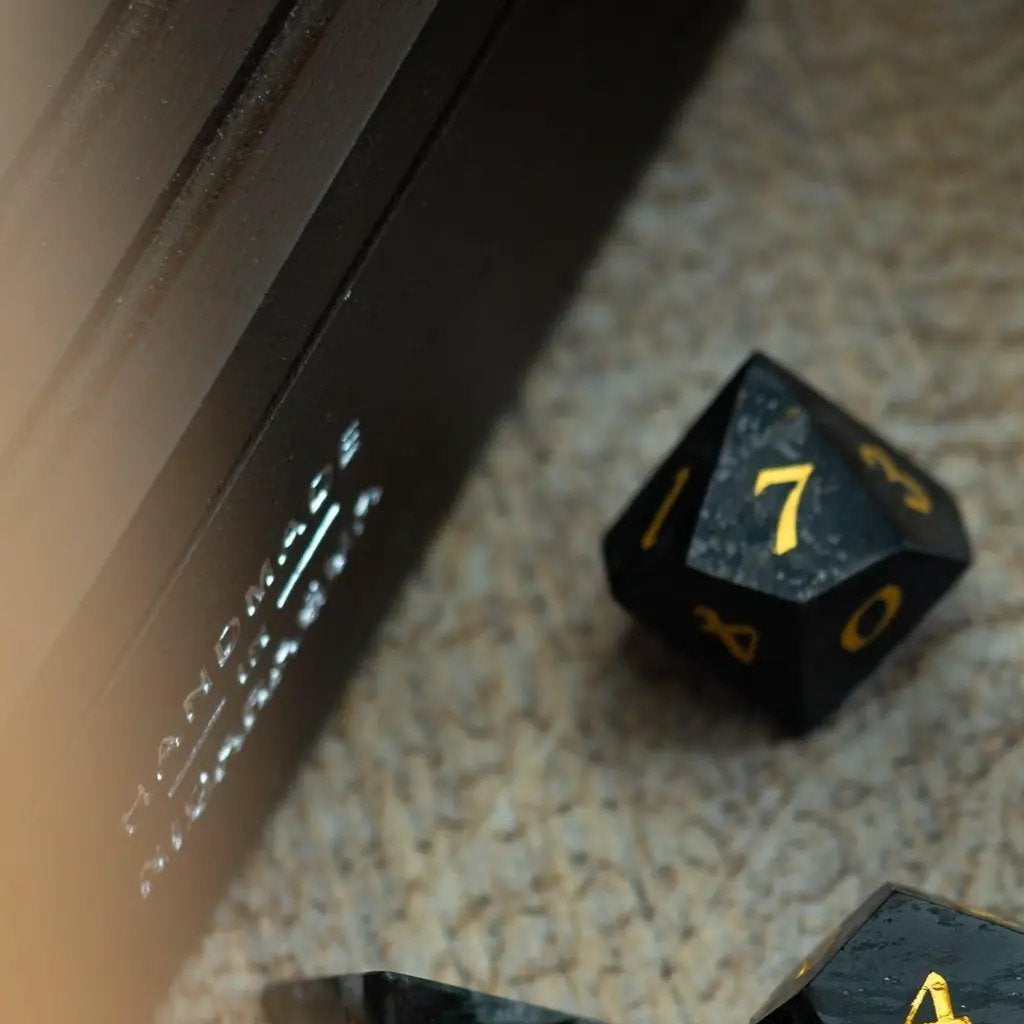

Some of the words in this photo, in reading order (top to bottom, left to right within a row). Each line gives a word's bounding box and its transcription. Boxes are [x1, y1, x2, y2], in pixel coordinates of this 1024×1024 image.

[640, 464, 691, 551] 1
[754, 462, 815, 556] 7
[857, 442, 933, 515] 3
[840, 583, 903, 654] 0
